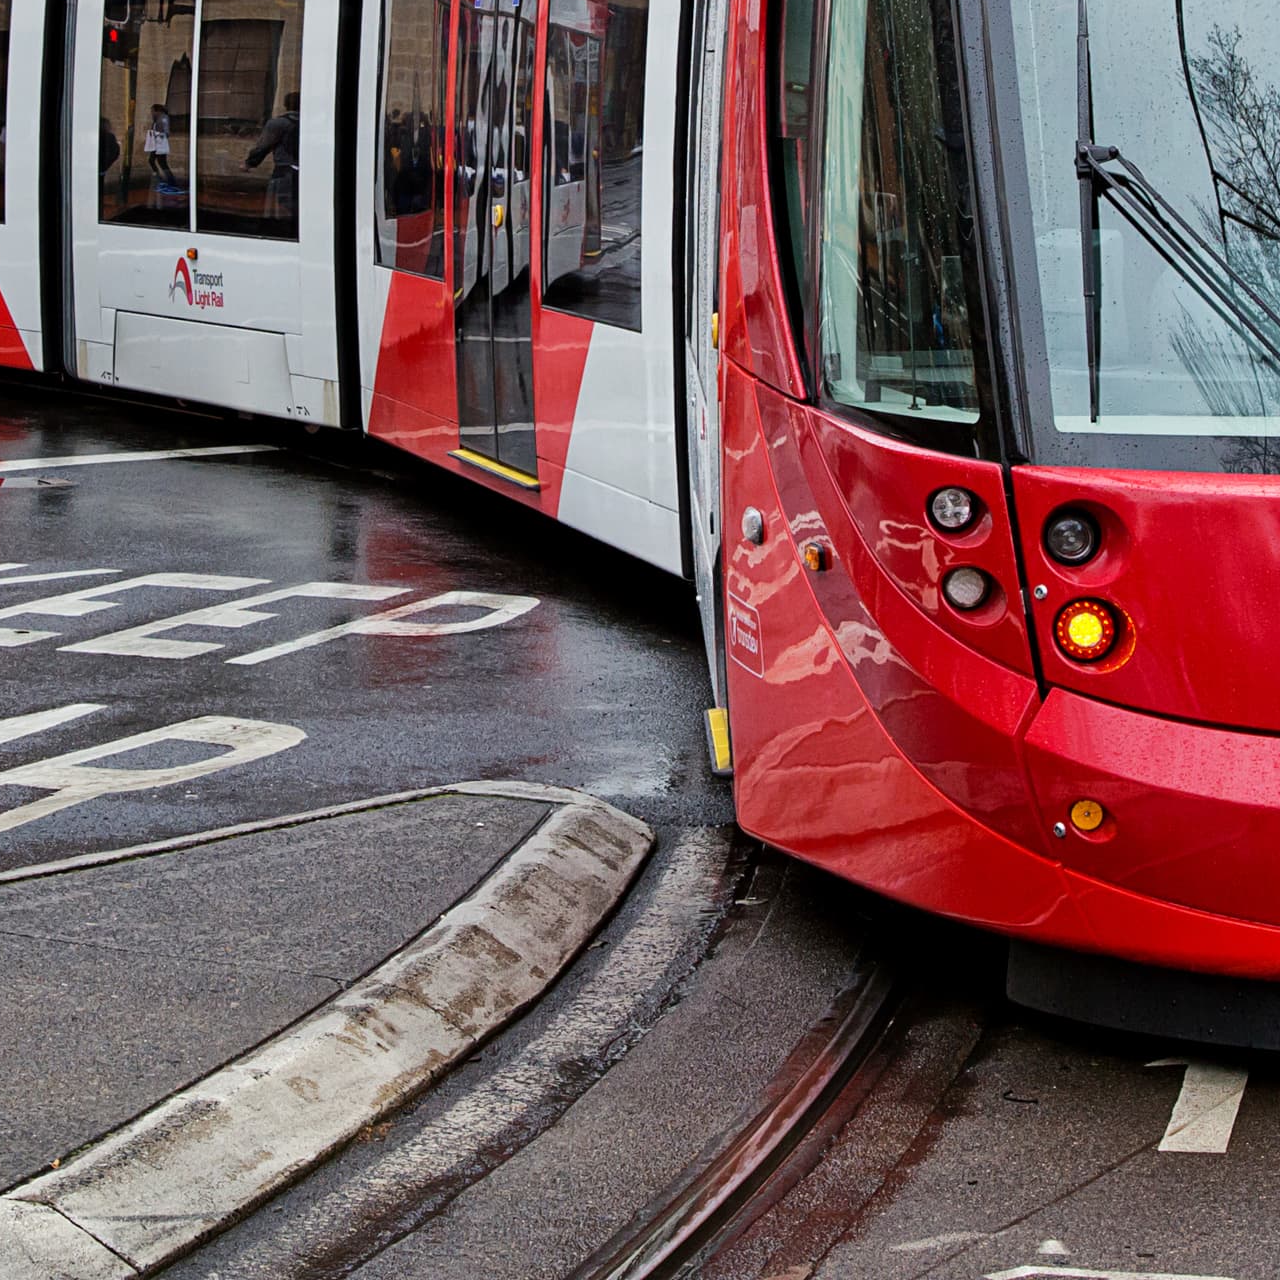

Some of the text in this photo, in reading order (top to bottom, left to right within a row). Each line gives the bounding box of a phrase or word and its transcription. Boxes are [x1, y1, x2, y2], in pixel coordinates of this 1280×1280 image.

[192, 269, 223, 289] Transport
[195, 290, 224, 309] Light Rail
